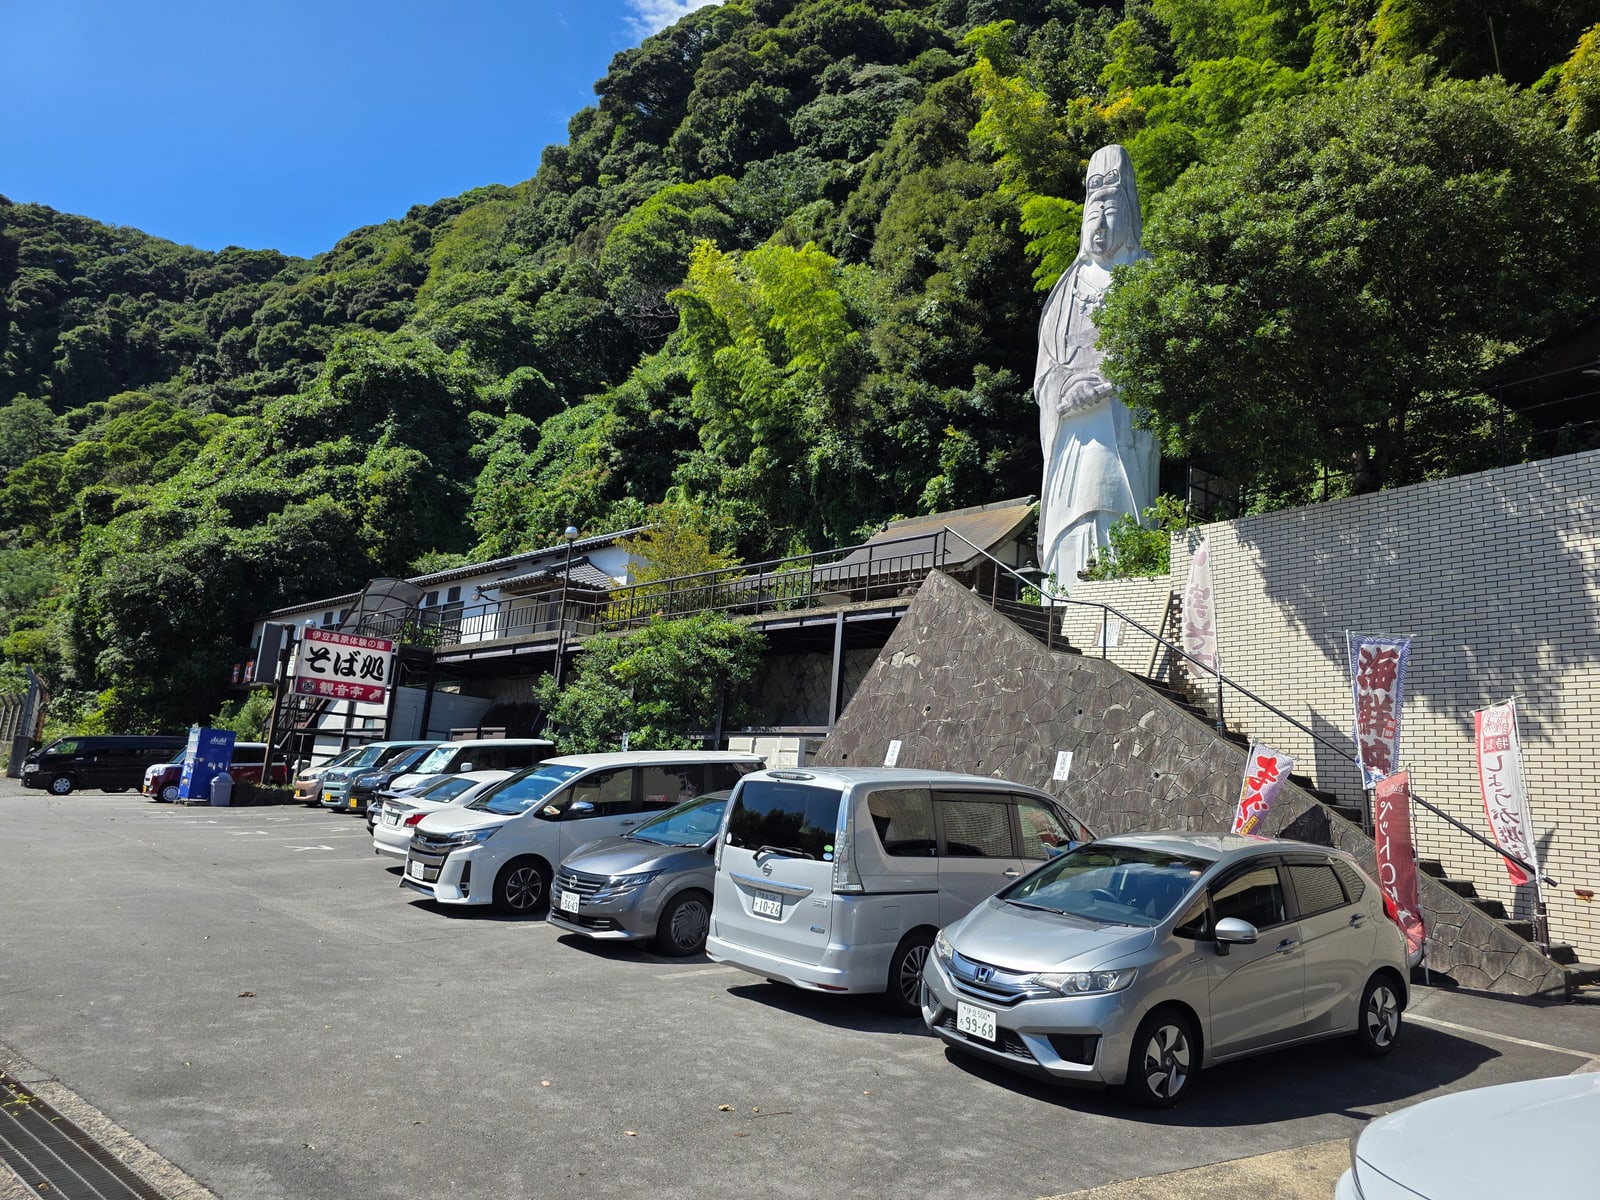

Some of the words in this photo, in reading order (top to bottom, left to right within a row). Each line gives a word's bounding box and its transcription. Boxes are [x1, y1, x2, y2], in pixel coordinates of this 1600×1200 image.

[312, 630, 385, 650] 伊豆高原体験の里
[304, 646, 384, 682] そば処
[319, 681, 364, 698] 観音亭
[759, 900, 780, 915] 10-26
[965, 1016, 994, 1038] 99-68
